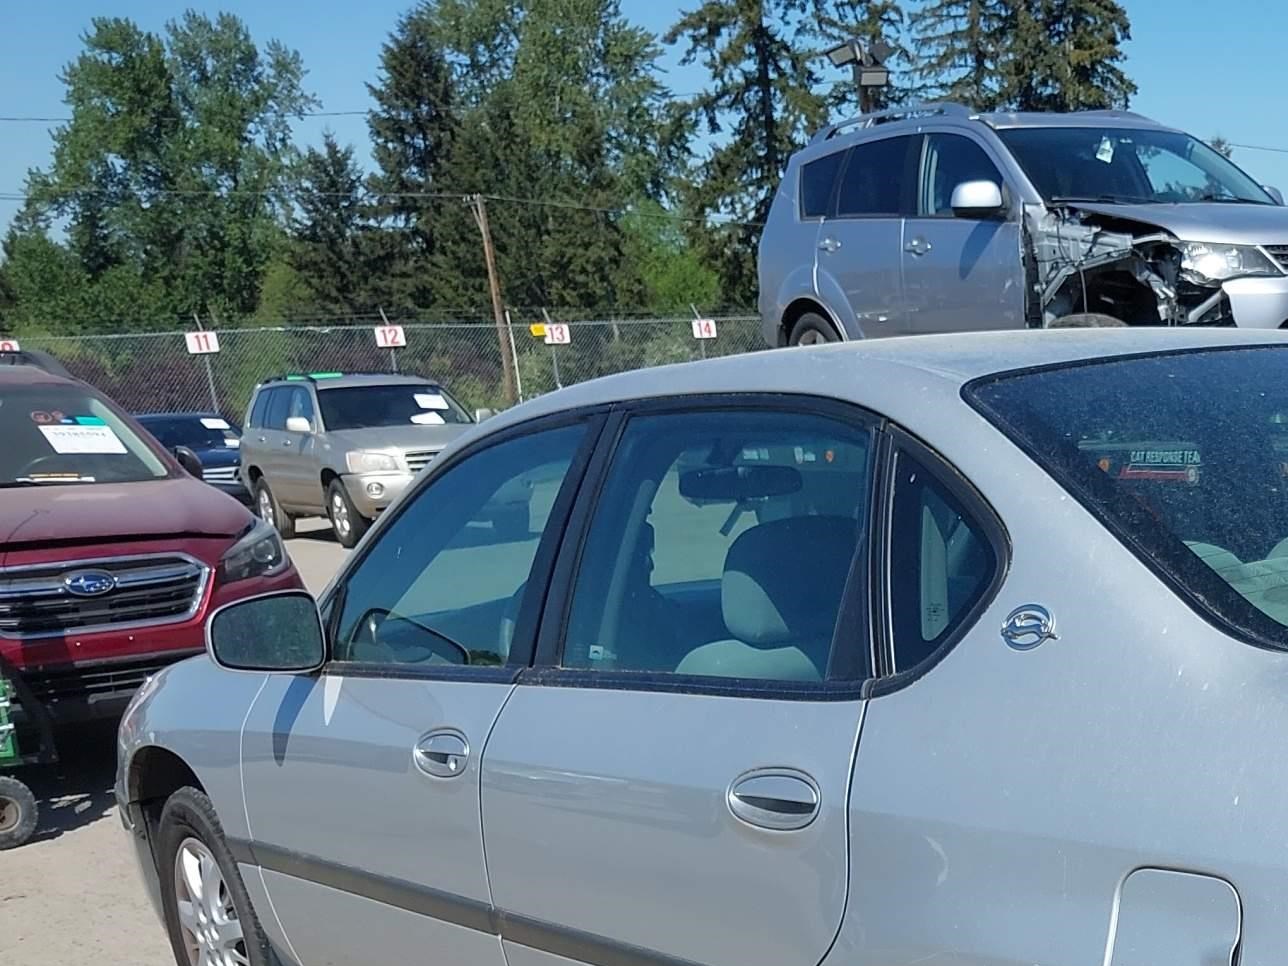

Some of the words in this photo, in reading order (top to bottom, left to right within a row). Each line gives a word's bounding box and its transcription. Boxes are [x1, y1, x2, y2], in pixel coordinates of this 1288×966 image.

[380, 328, 400, 345] 12
[549, 326, 565, 343] 13
[698, 322, 712, 337] 14
[194, 333, 210, 351] 11
[1184, 450, 1201, 463] TEA
